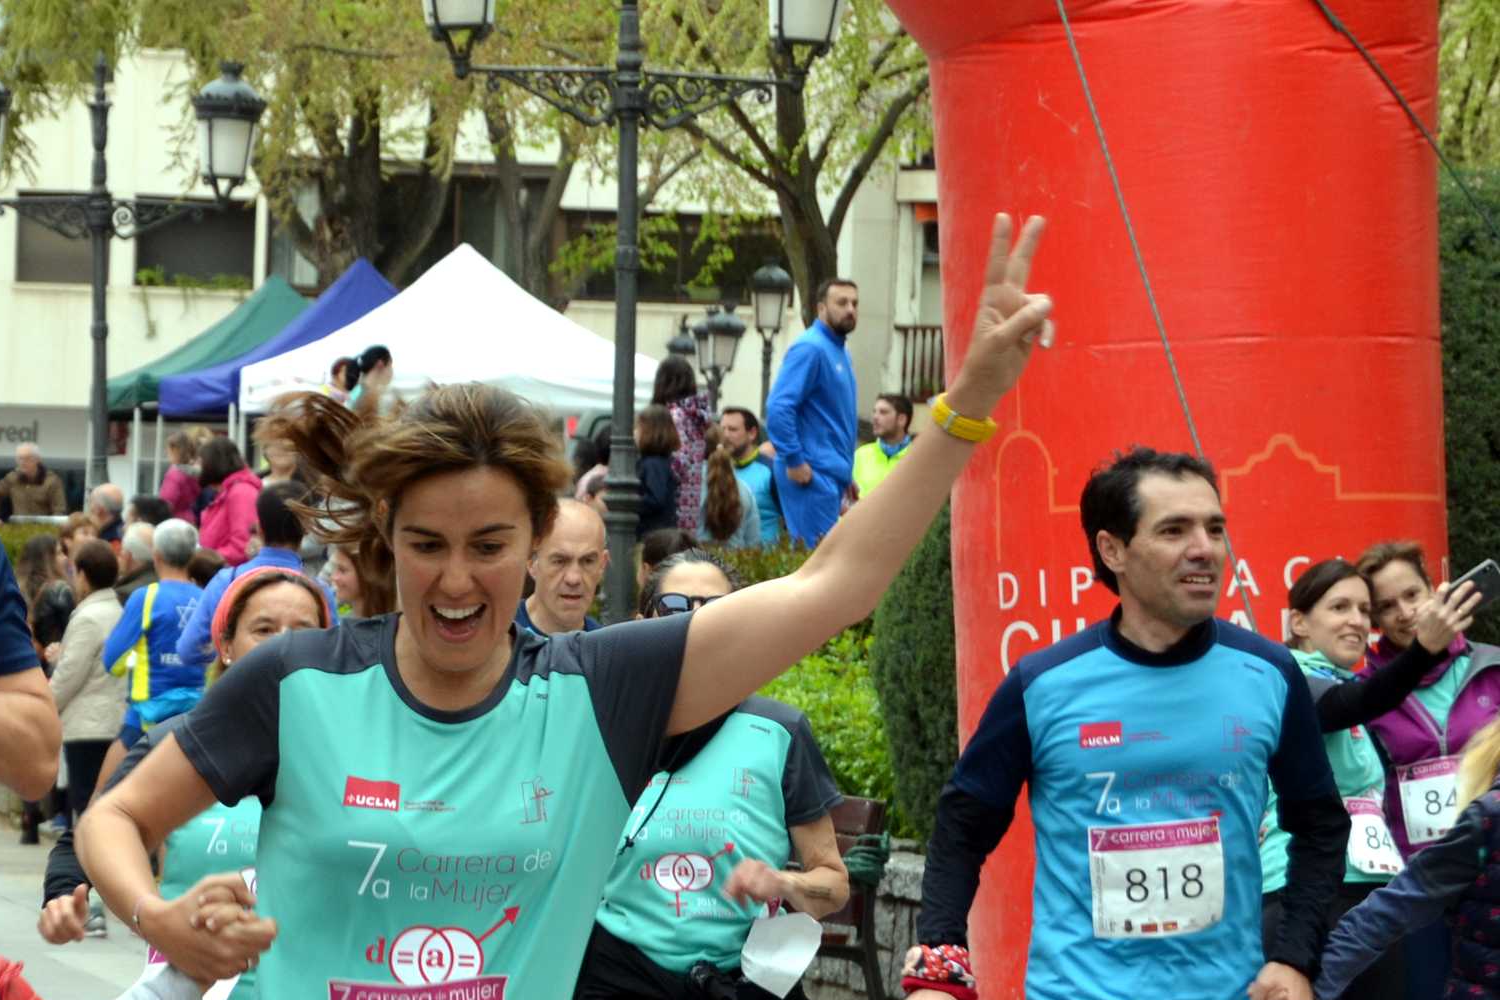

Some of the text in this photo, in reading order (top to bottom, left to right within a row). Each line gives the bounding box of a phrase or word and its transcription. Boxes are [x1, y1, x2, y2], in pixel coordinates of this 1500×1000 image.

[1088, 735, 1121, 747] UCLM
[356, 794, 397, 809] UCLM
[651, 807, 726, 823] Carrera
[675, 823, 728, 841] Mujer
[1111, 828, 1165, 845] carrera
[396, 848, 517, 875] Carrera
[523, 848, 553, 873] de
[1125, 863, 1204, 903] 818
[410, 876, 516, 912] la Mujer
